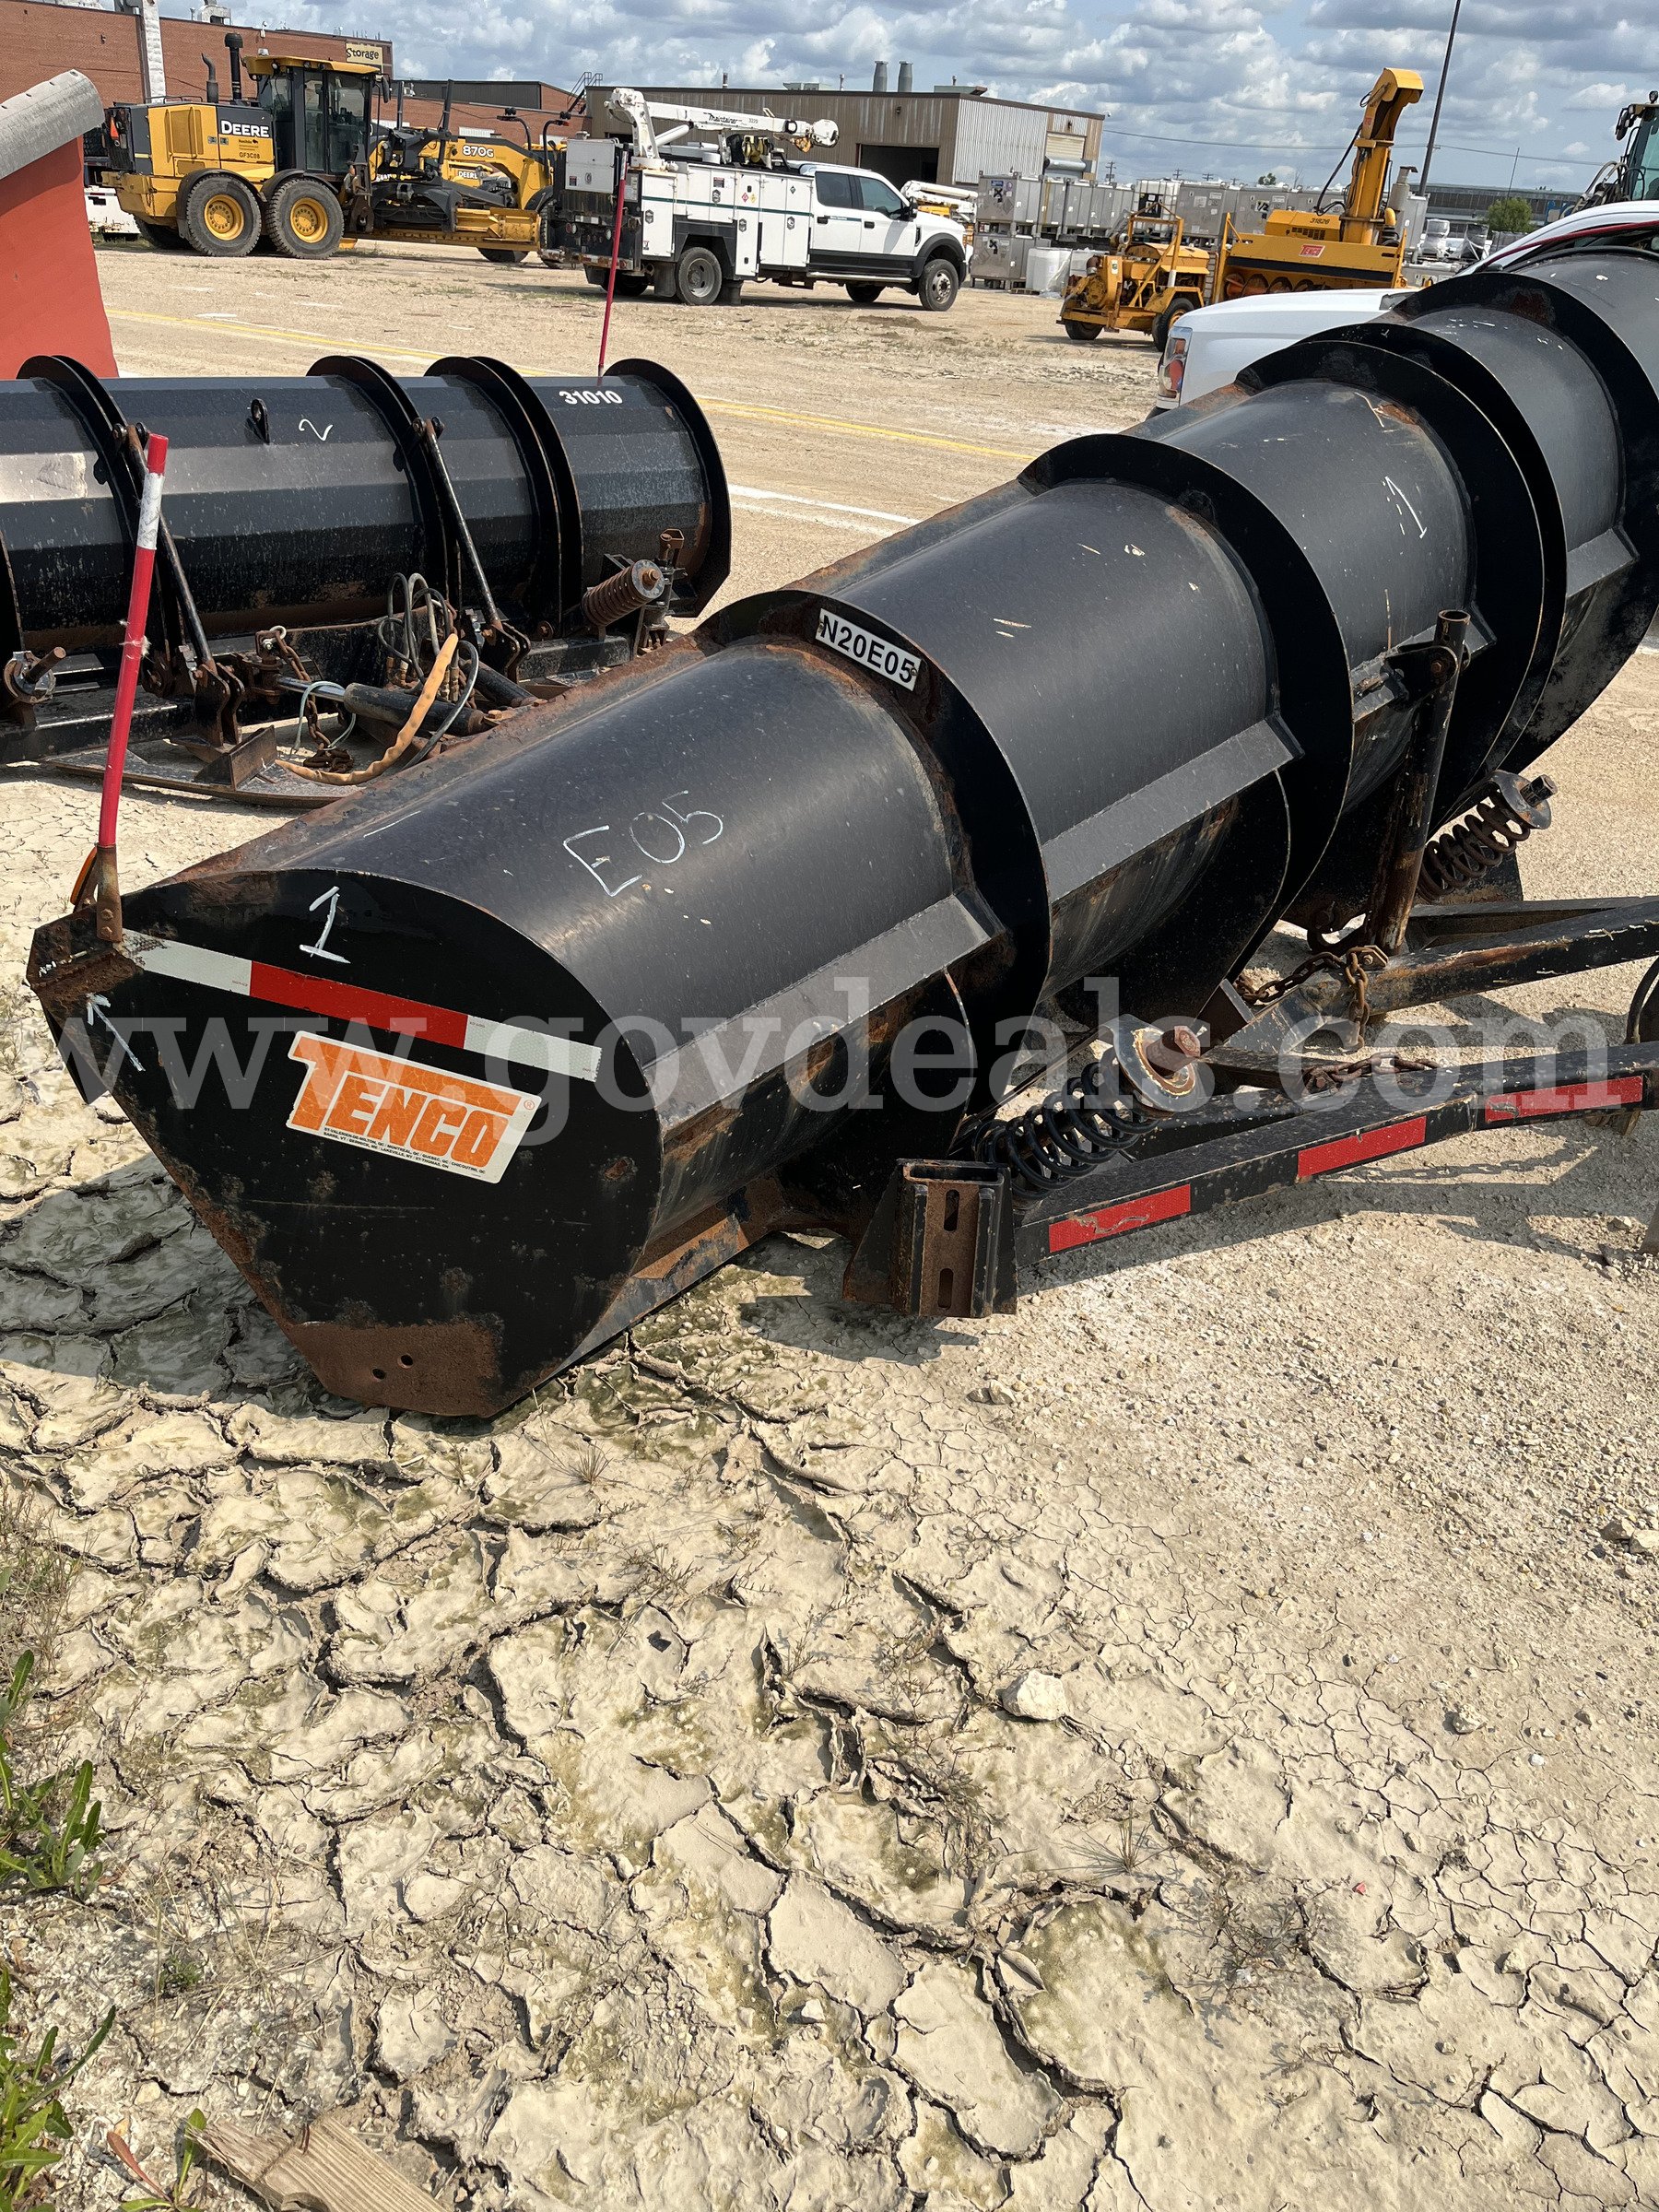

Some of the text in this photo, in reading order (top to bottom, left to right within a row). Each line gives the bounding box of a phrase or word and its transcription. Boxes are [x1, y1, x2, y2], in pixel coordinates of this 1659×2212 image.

[346, 48, 379, 60] Storage
[221, 120, 269, 137] DEERE
[463, 145, 494, 158] 870G
[559, 390, 623, 405] 31010
[819, 615, 915, 683] N20E05
[299, 886, 351, 964] 1
[291, 1035, 524, 1169] TENCO
